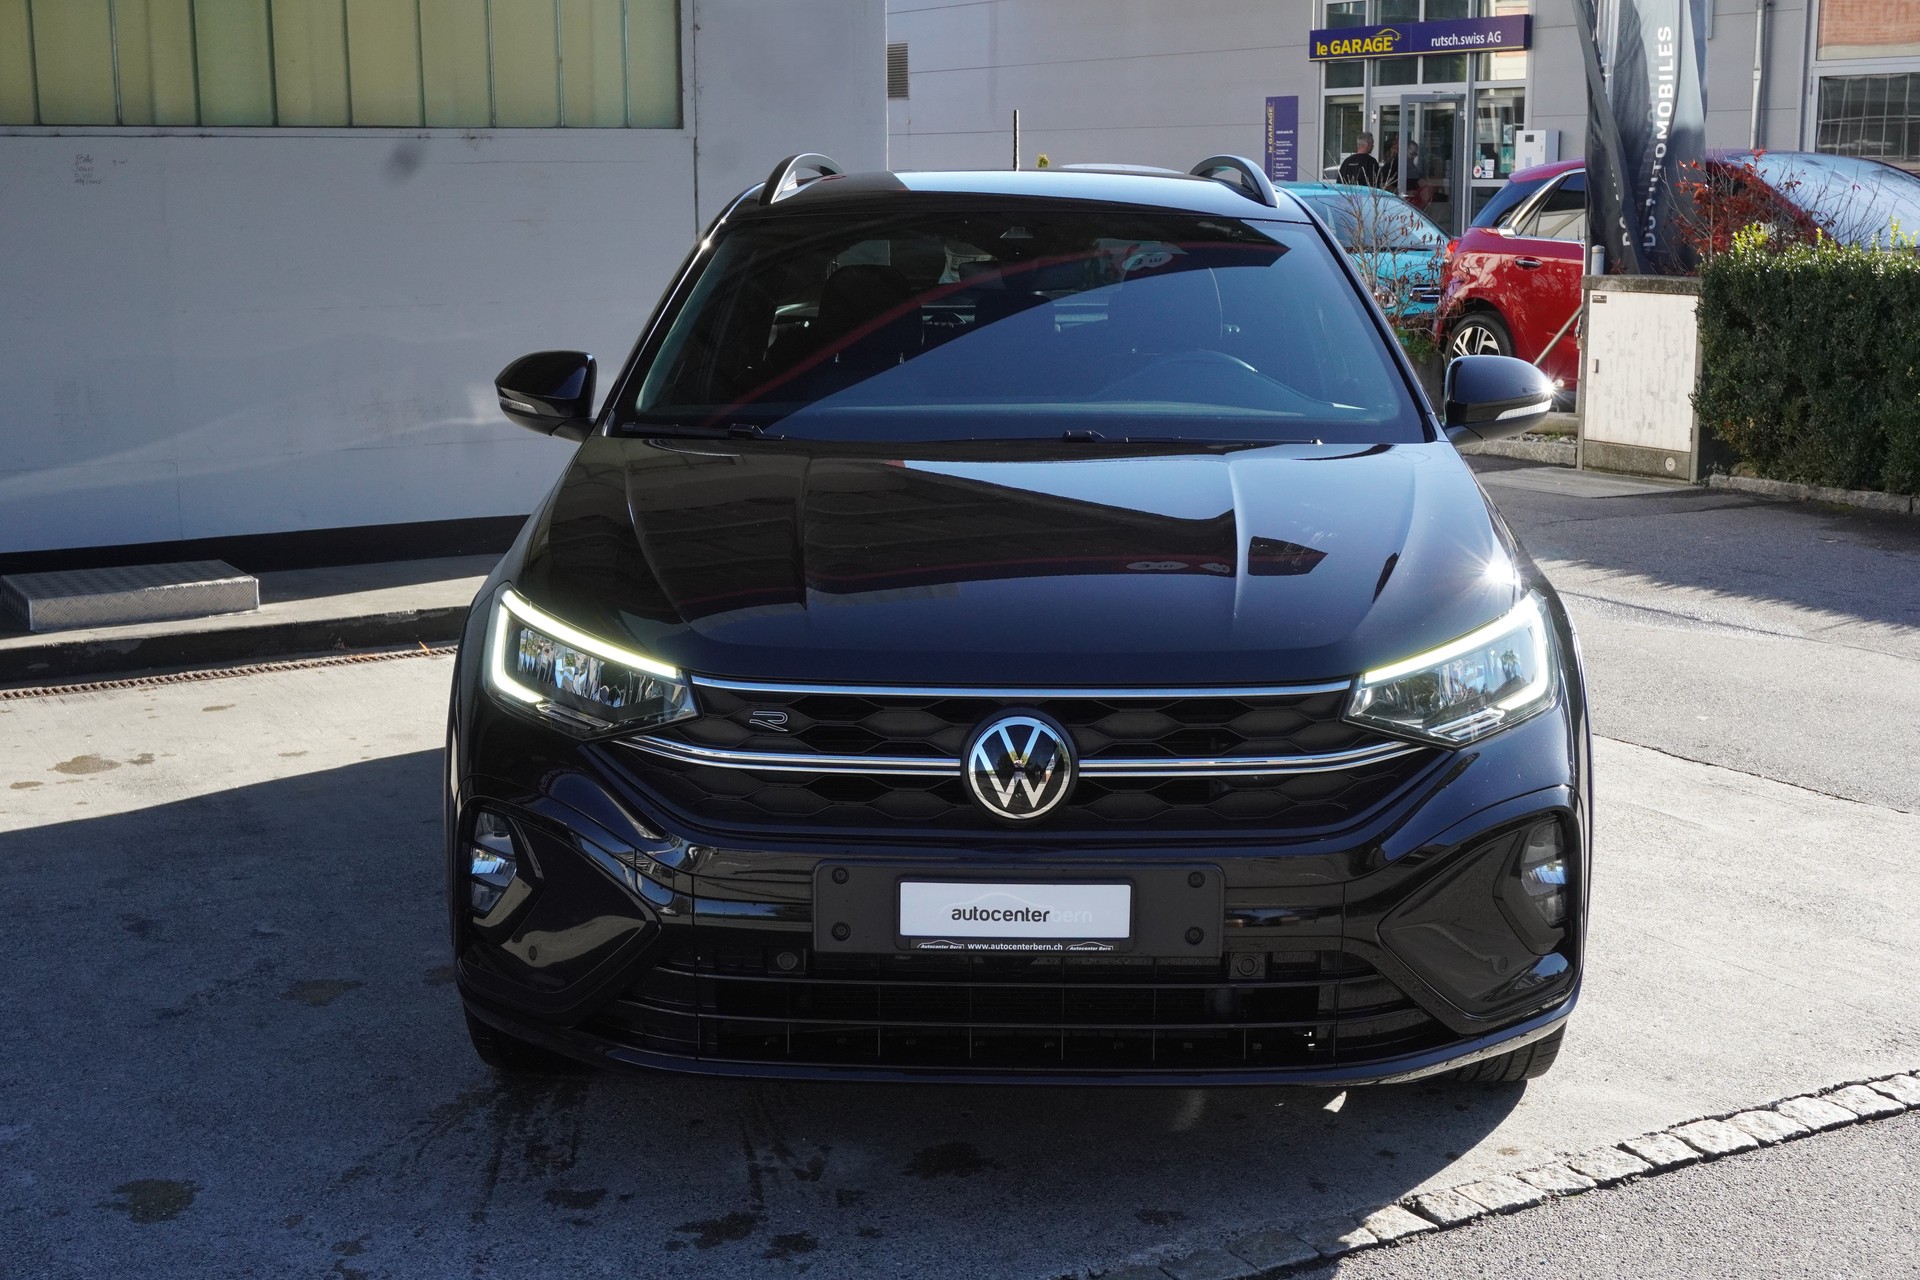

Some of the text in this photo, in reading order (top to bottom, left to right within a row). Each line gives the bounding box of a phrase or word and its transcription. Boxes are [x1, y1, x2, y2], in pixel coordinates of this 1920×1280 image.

[1316, 36, 1394, 55] le GARAGE
[1431, 31, 1502, 47] rutsch.swiss AG
[967, 943, 1063, 951] www.autocenterbern.ch
